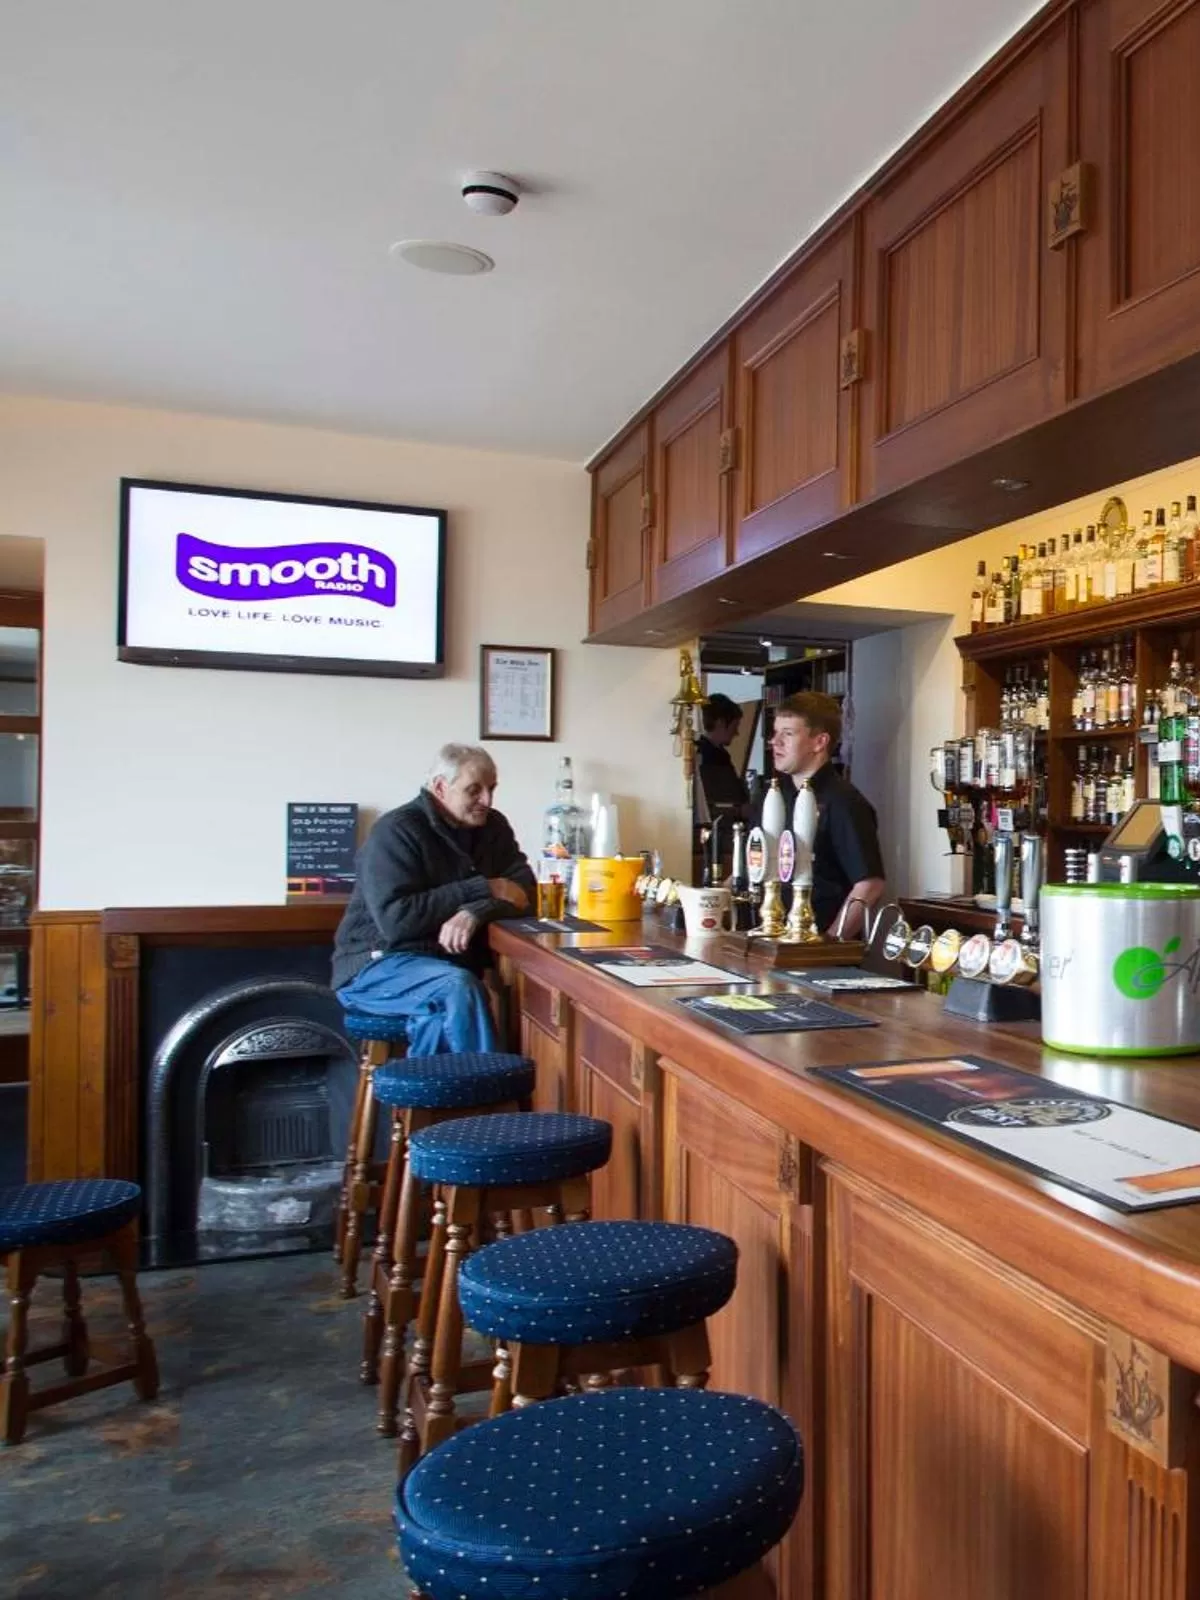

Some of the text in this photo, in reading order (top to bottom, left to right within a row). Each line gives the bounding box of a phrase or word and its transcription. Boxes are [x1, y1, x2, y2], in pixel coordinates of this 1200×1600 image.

[188, 552, 386, 588] smooth
[315, 581, 364, 592] RADIO
[188, 608, 231, 618] LOVE
[282, 614, 321, 624] LOVE
